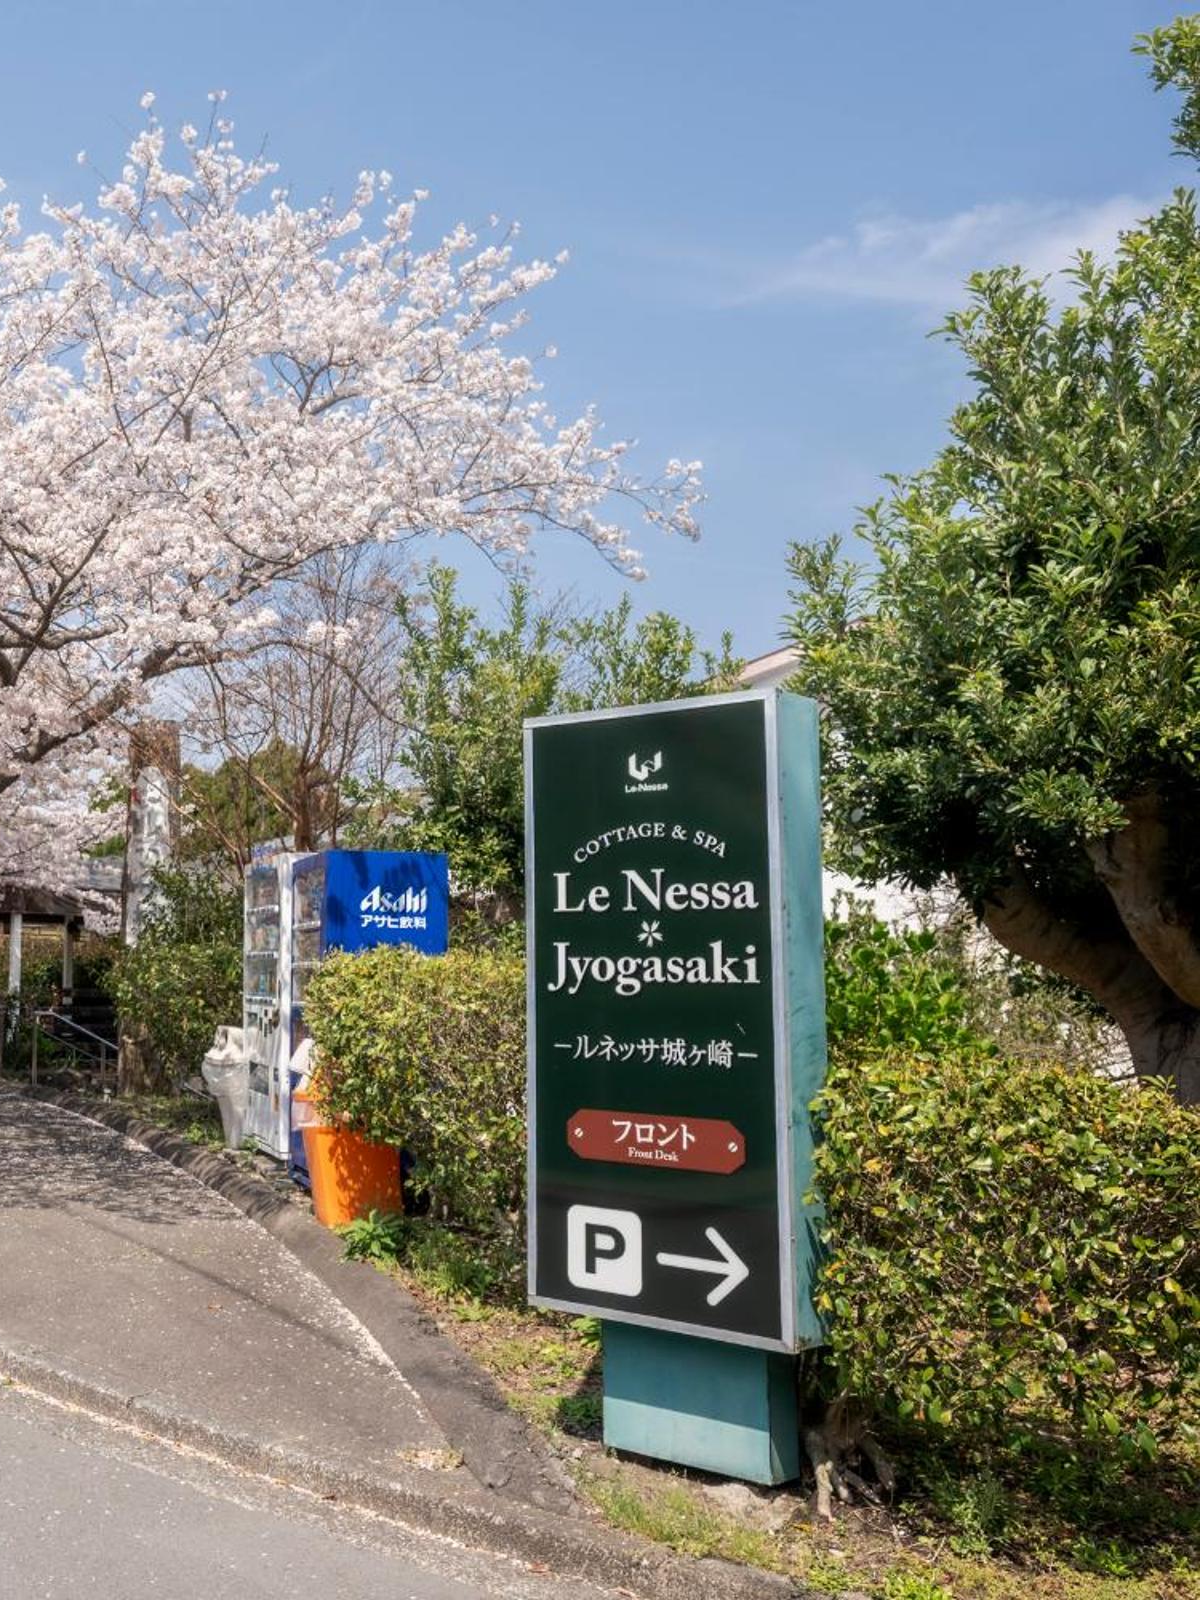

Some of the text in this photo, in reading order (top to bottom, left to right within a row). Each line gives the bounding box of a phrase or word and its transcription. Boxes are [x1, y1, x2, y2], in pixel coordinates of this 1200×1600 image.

[573, 822, 727, 863] COTTAGE & SPA
[359, 885, 428, 913] Asahi
[553, 868, 760, 913] Le Nessa
[360, 914, 428, 930] アサヒ飲料
[547, 939, 761, 996] Jyogasaki
[612, 1119, 696, 1151] フロント
[628, 1146, 680, 1162] Front Desk
[585, 1222, 626, 1275] P
